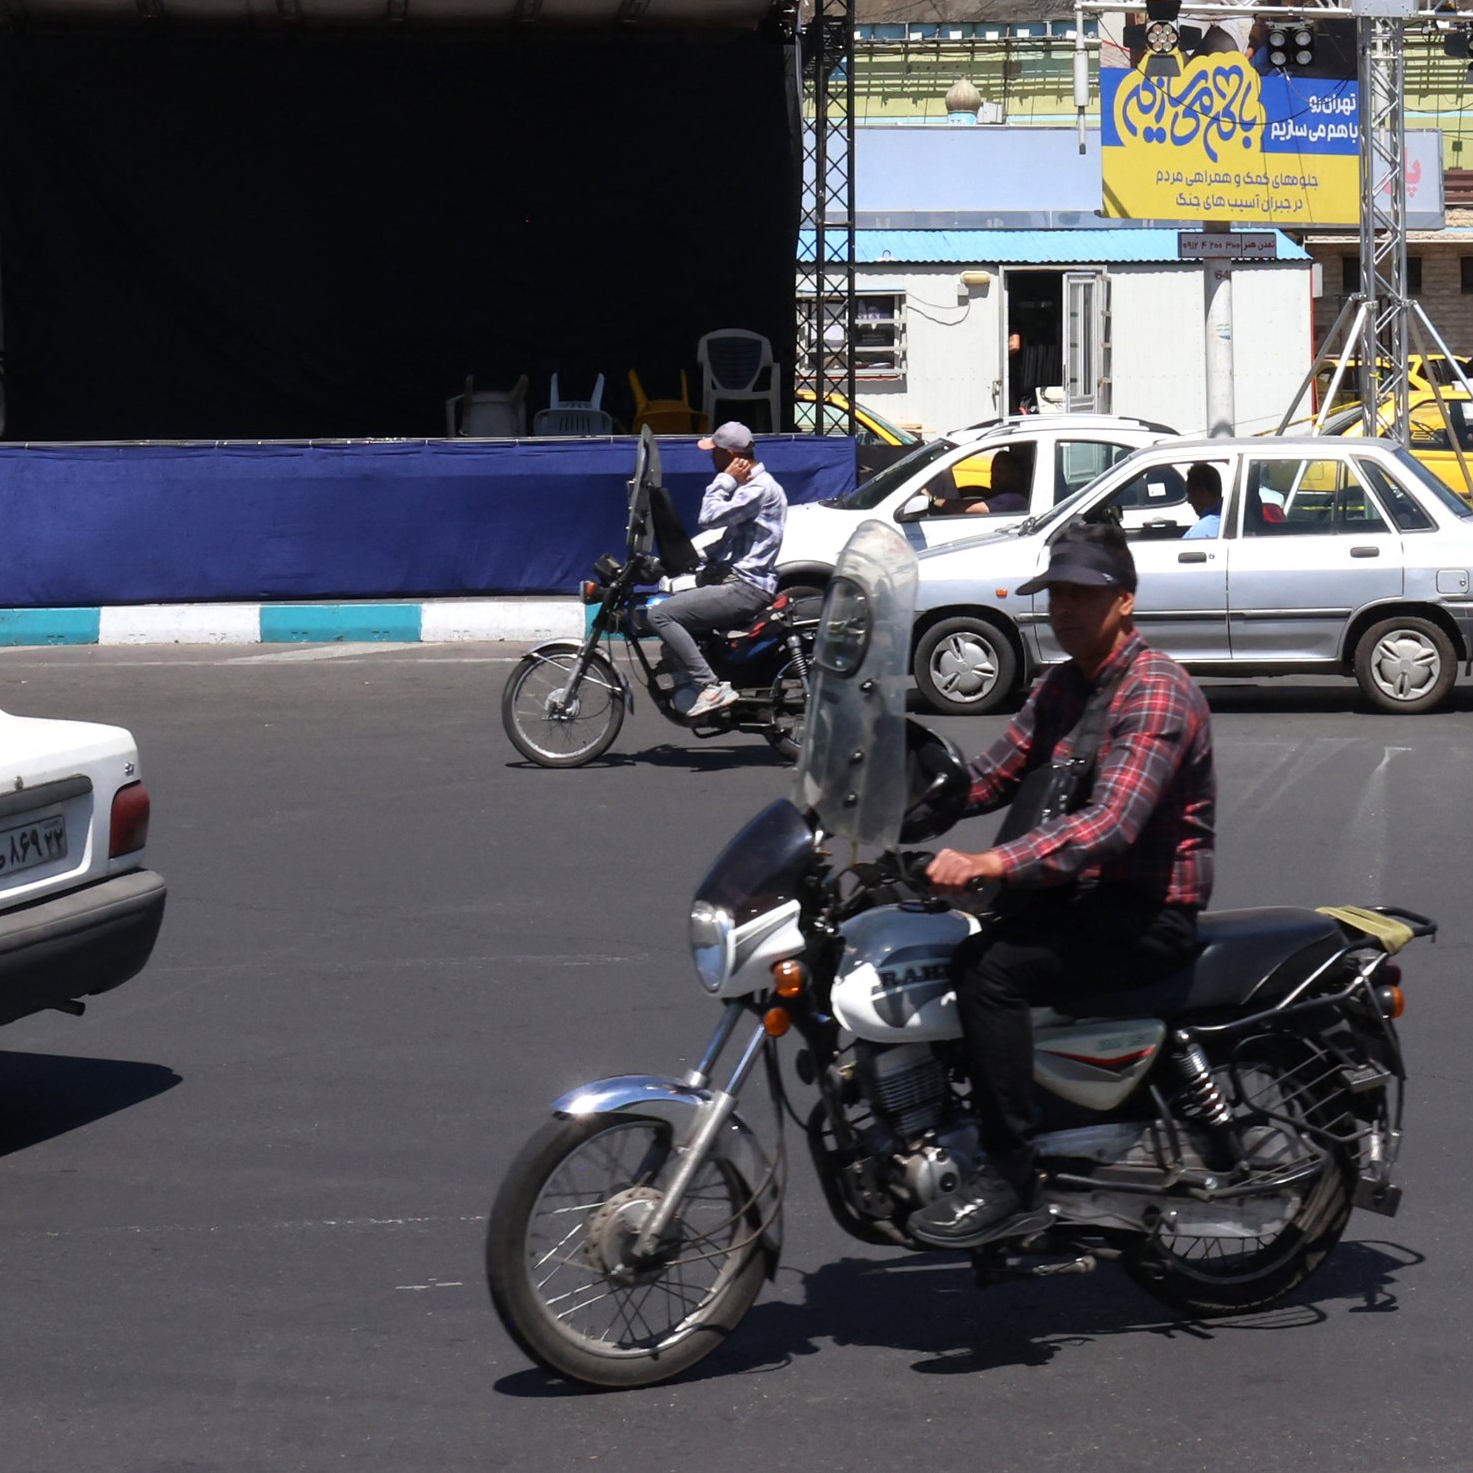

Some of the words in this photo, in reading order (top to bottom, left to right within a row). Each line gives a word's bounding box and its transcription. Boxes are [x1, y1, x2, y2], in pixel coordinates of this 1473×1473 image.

[1320, 92, 1357, 114] تهران
[1270, 119, 1308, 142] سازیم
[1155, 171, 1183, 186] مردم
[1185, 170, 1232, 187] همراهی
[1235, 175, 1242, 188] و
[1244, 171, 1270, 186] کمک
[1176, 192, 1201, 208] جنگ
[1203, 195, 1225, 210] های
[1227, 193, 1260, 213] آسیب
[1260, 196, 1291, 213] جبران
[1293, 197, 1303, 213] در
[1243, 241, 1256, 251] هنر
[1257, 240, 1275, 251] تمدن
